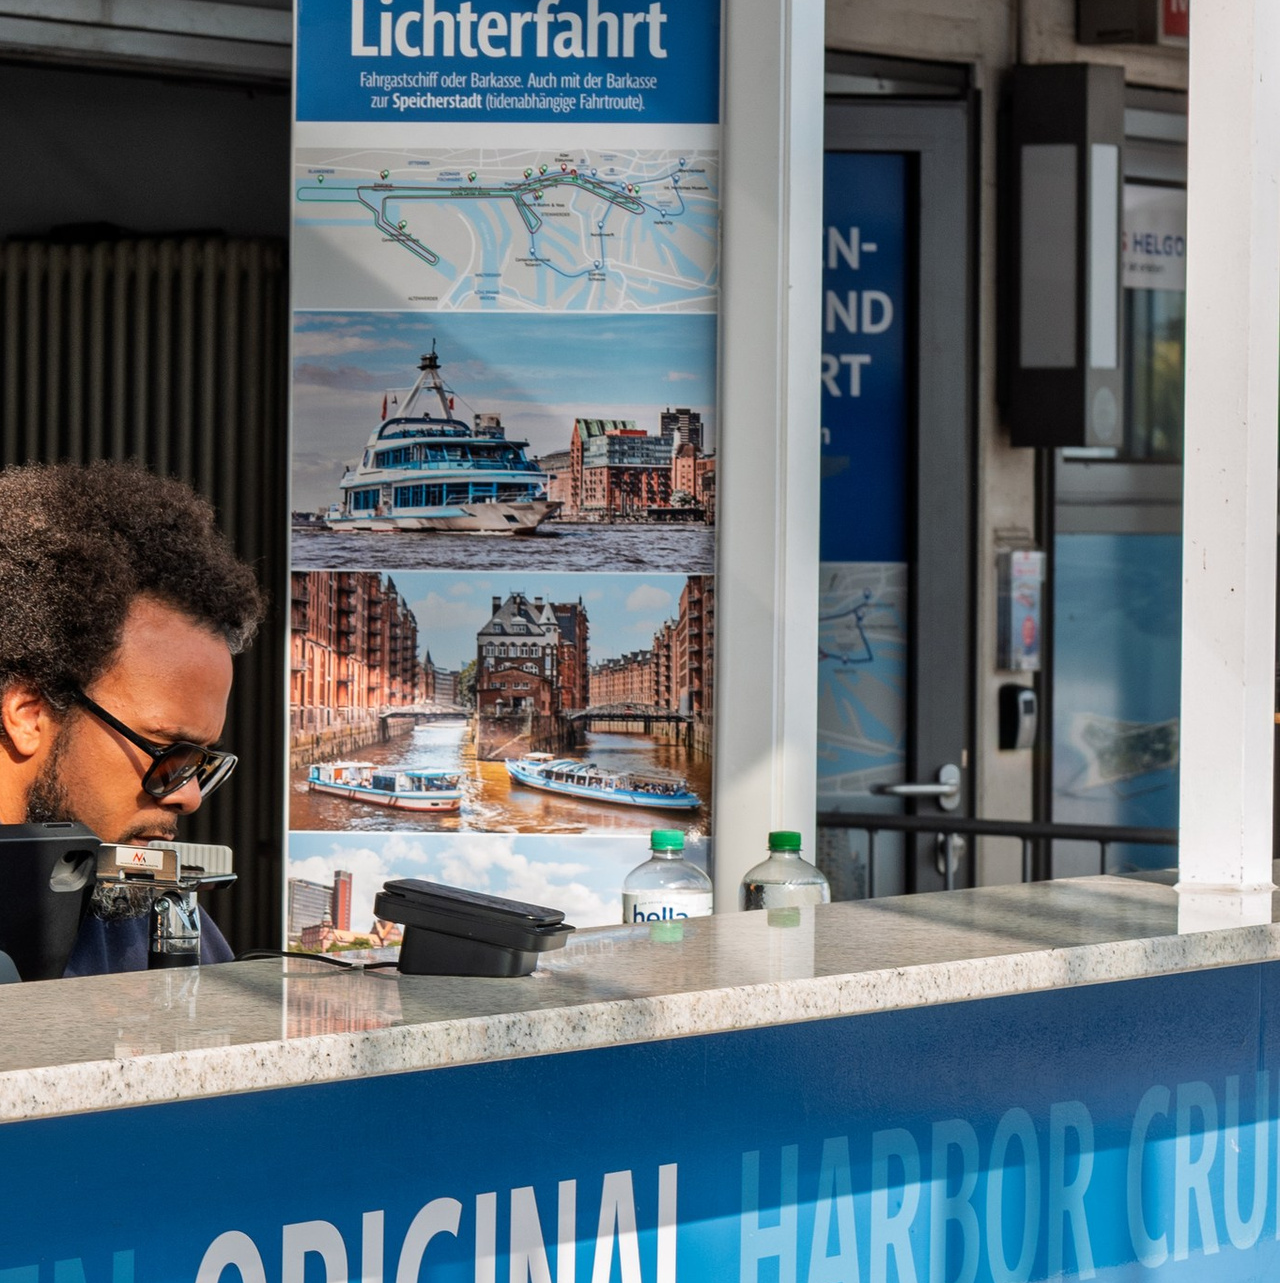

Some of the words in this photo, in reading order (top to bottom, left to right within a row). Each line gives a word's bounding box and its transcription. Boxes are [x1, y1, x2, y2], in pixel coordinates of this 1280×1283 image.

[359, 71, 438, 92] Fahrgastschiff
[440, 72, 468, 89] oder
[470, 72, 524, 89] Barkasse.
[527, 72, 558, 90] Auch
[561, 72, 580, 90] mit
[584, 72, 603, 90] der
[606, 72, 657, 90] Barkasse
[370, 96, 389, 109] zur
[392, 92, 482, 113] Speicherstadt
[485, 92, 577, 114] (tidenabhängige
[579, 92, 646, 113] Fahrtroute).
[1127, 1069, 1280, 1269] CRU
